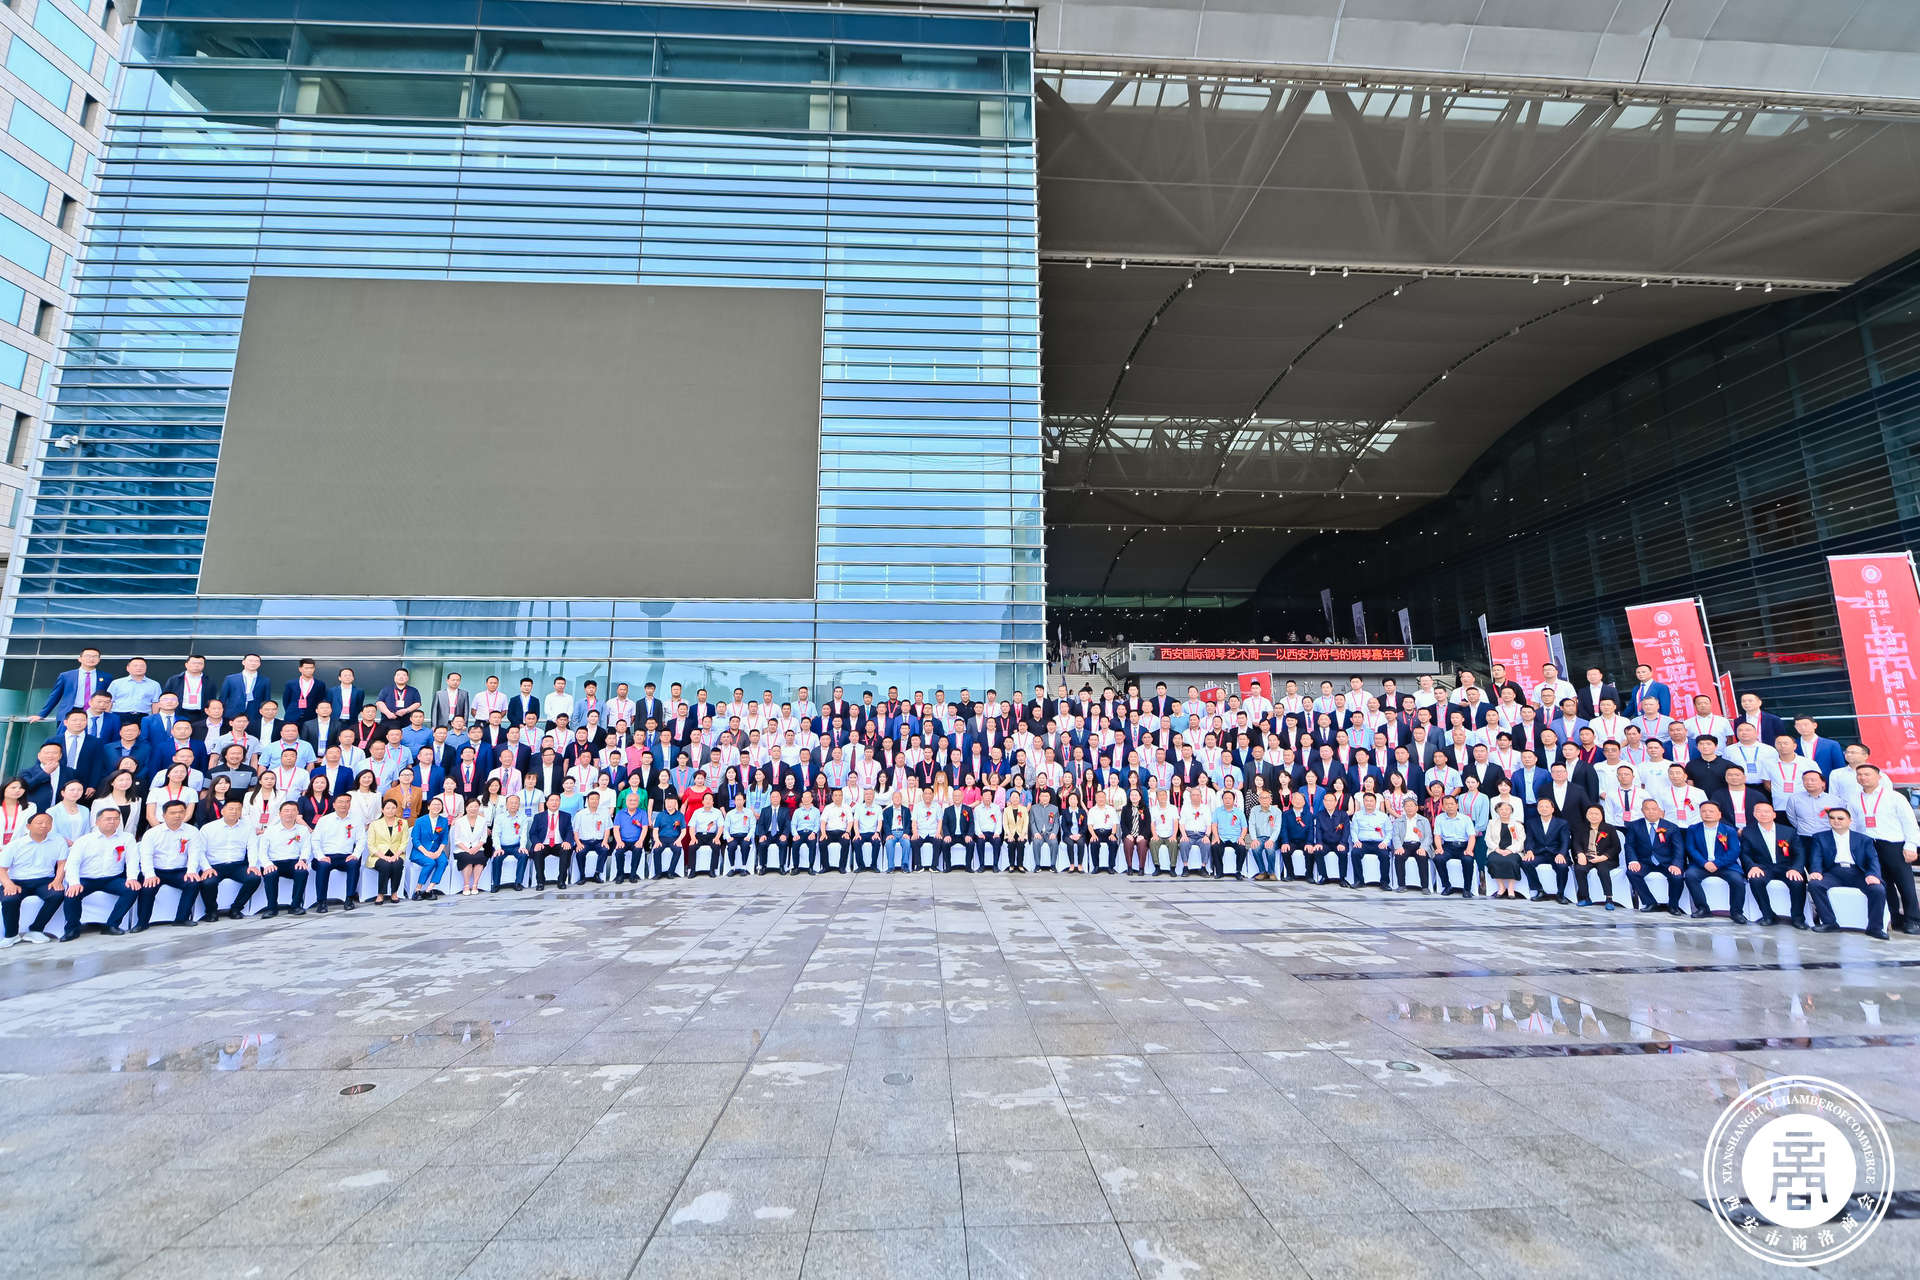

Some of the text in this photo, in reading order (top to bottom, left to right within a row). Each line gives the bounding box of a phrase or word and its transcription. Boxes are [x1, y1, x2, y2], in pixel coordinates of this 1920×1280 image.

[1160, 647, 1404, 661] 西安国际钢琴艺术周——以西安为符号的钢琴嘉年华
